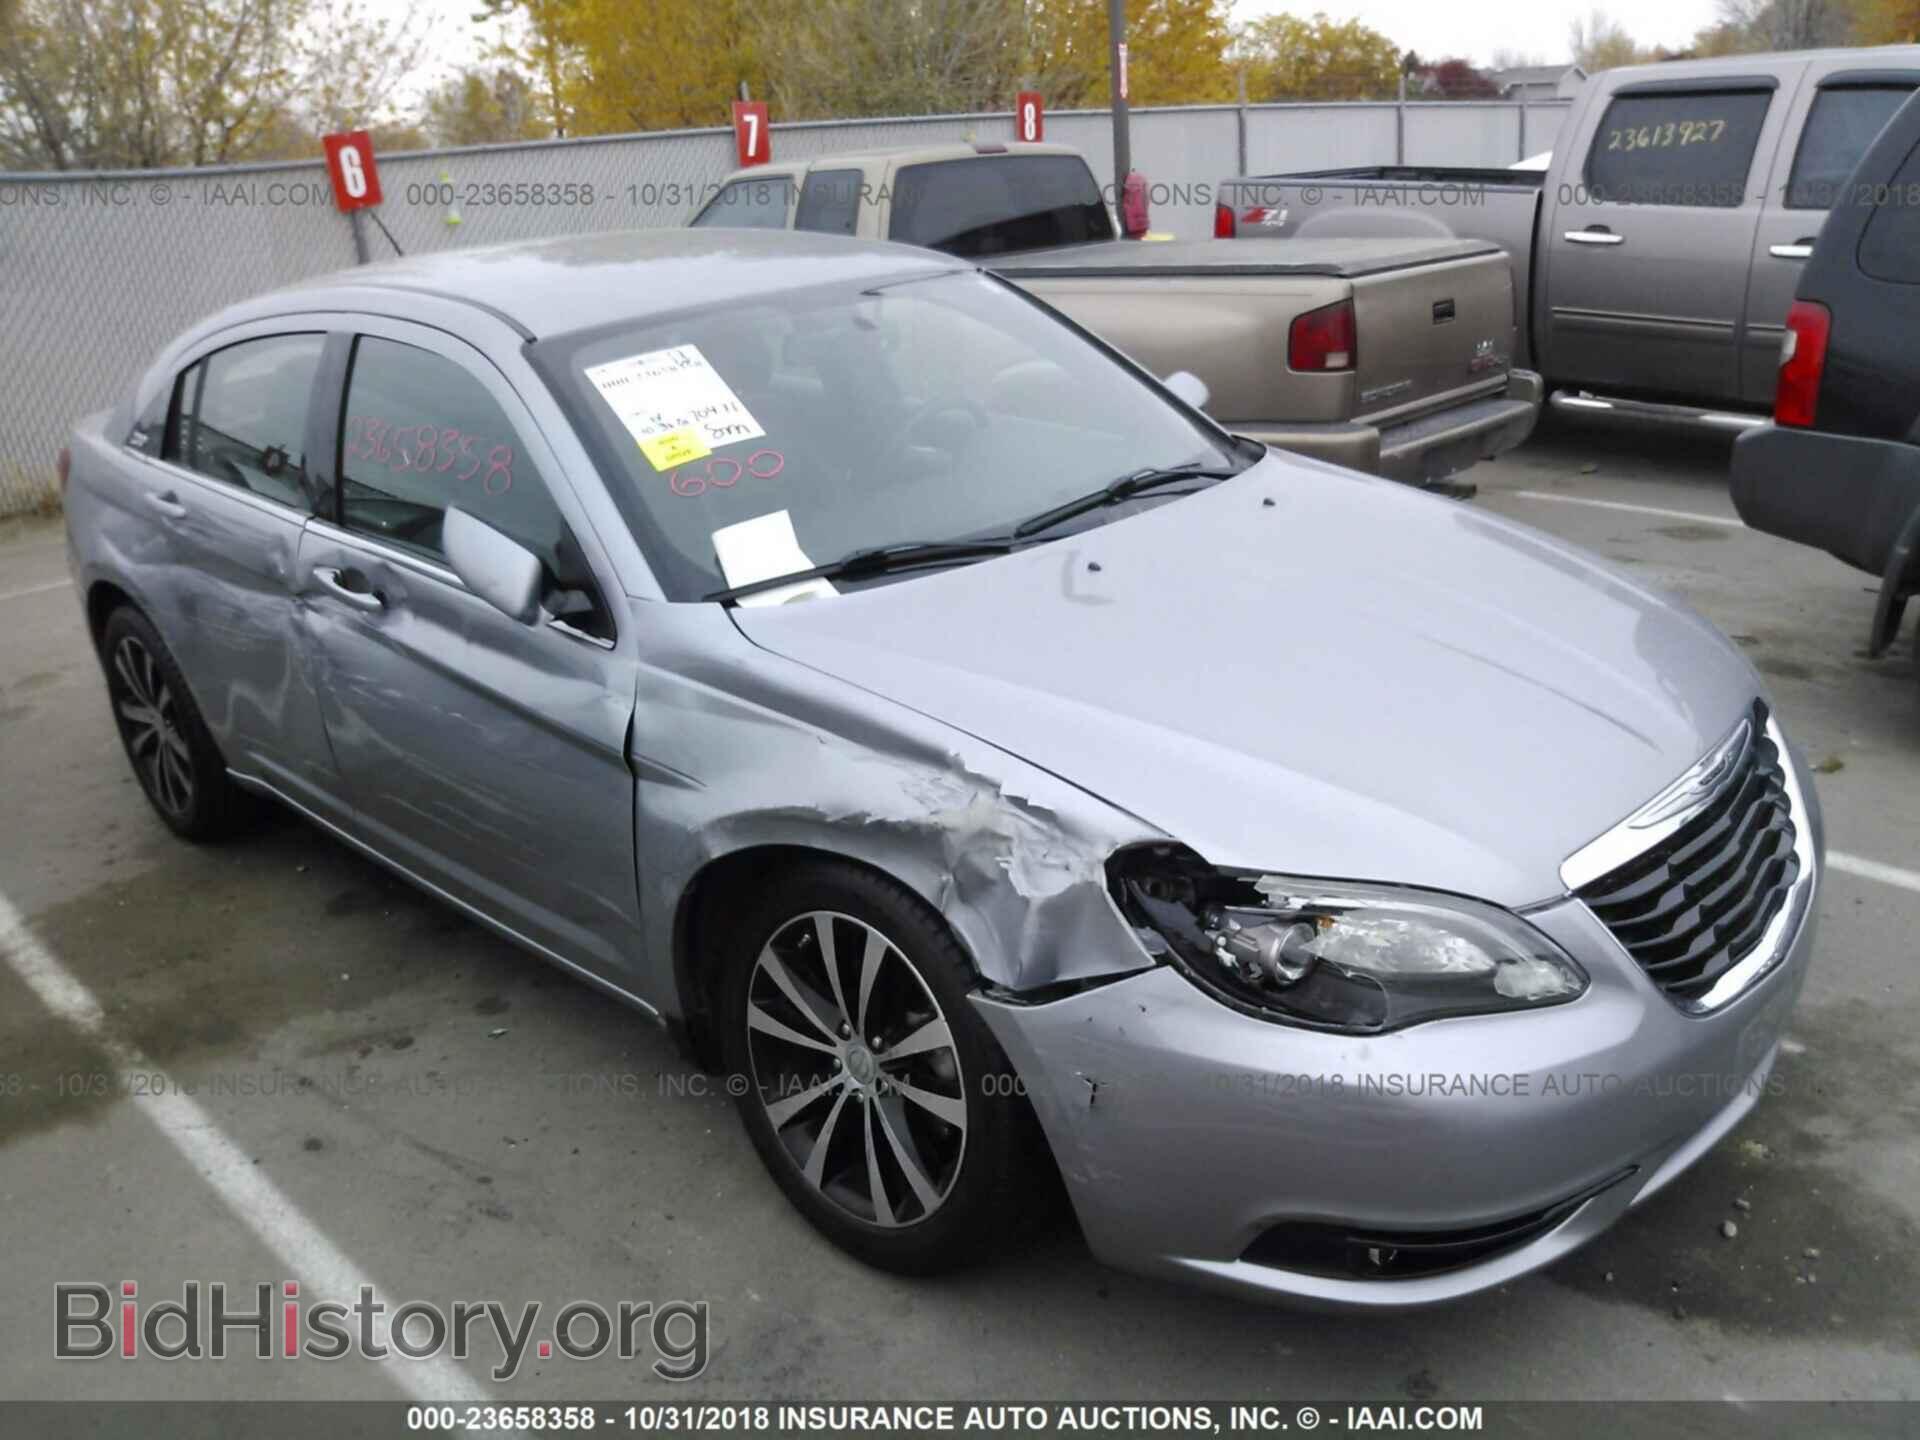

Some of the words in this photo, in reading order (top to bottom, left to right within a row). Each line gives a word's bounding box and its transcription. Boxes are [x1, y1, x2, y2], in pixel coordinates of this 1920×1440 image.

[743, 113, 758, 157] 7
[1024, 102, 1036, 141] 8
[1608, 119, 1726, 152] 23613927
[339, 145, 367, 198] 6
[670, 448, 785, 497] 600
